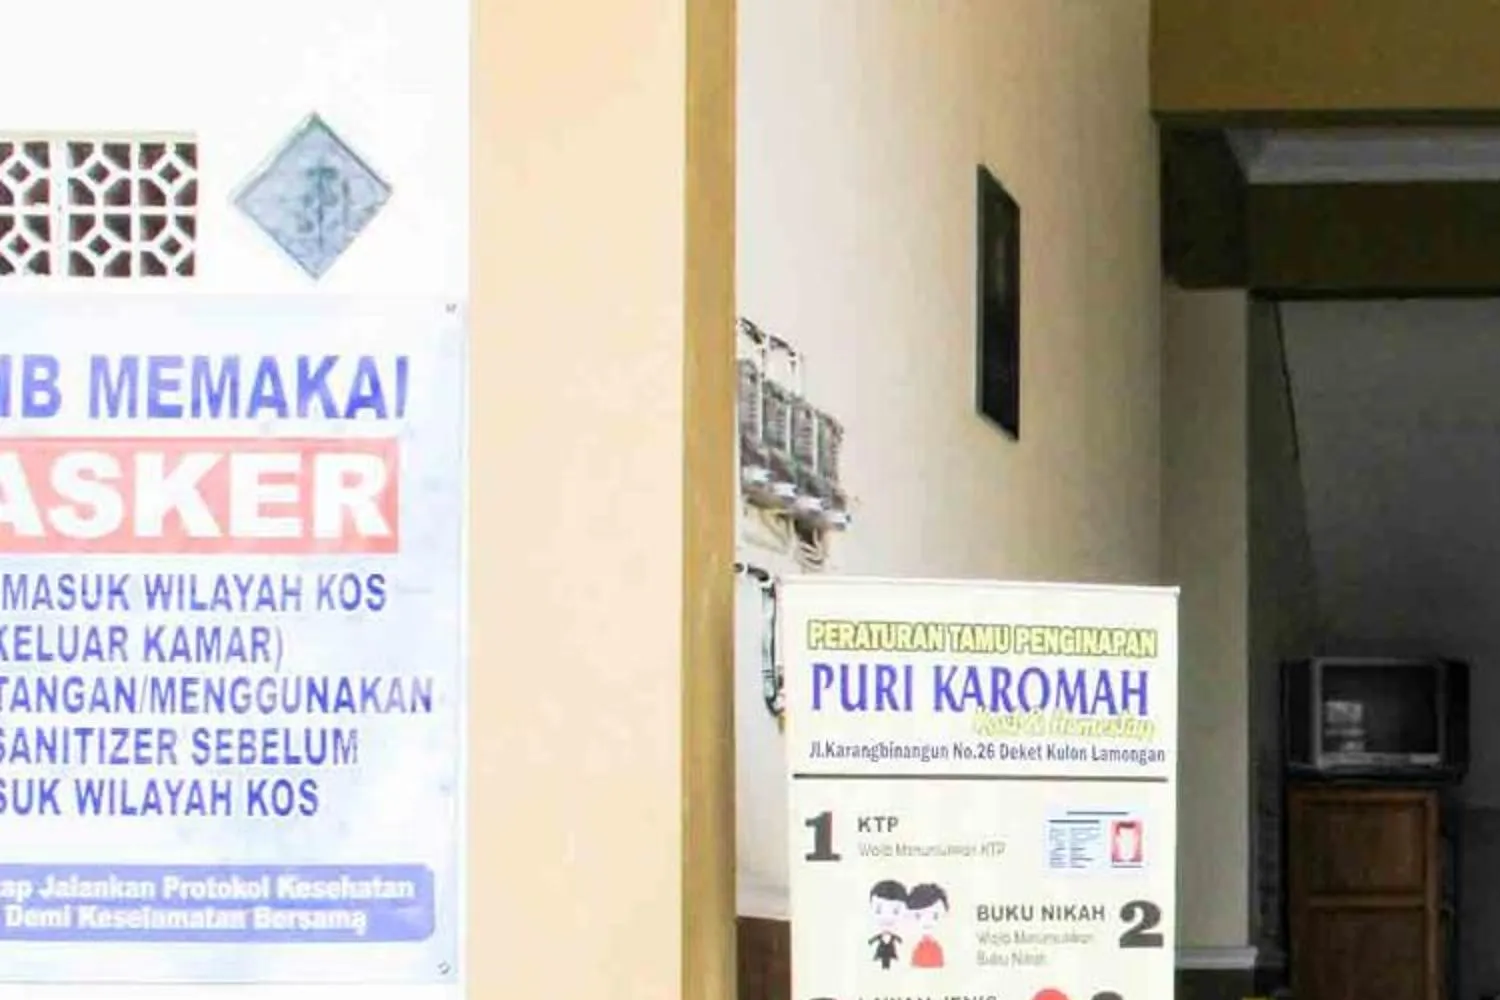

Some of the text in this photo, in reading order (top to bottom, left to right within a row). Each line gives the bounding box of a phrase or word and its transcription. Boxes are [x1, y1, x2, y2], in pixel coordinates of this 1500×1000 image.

[89, 355, 409, 419] MEMAKAI
[3, 573, 387, 612] MASUK WILAYAH KOS
[144, 625, 283, 672] KAMAR)
[807, 619, 1158, 658] PERATURAN TAMU PENGINAPAN
[811, 663, 1149, 717] PURI KAROMAH
[192, 727, 359, 765] SEBELUM
[952, 744, 995, 760] No.26
[1000, 743, 1043, 761] Deket
[1046, 745, 1088, 762] Kulon
[1091, 746, 1166, 766] Lamongan
[75, 778, 231, 816] WILAYAH
[247, 778, 320, 816] KOS
[805, 811, 841, 862] 1
[858, 816, 899, 834] KTP
[39, 873, 156, 899] Jalankan
[163, 874, 271, 899] Protokol
[277, 874, 415, 899] Kesehatan
[5, 904, 367, 935] Demi Keselamatan Bersama
[977, 904, 1106, 922] BUKU NIKAH
[1119, 900, 1164, 949] 2
